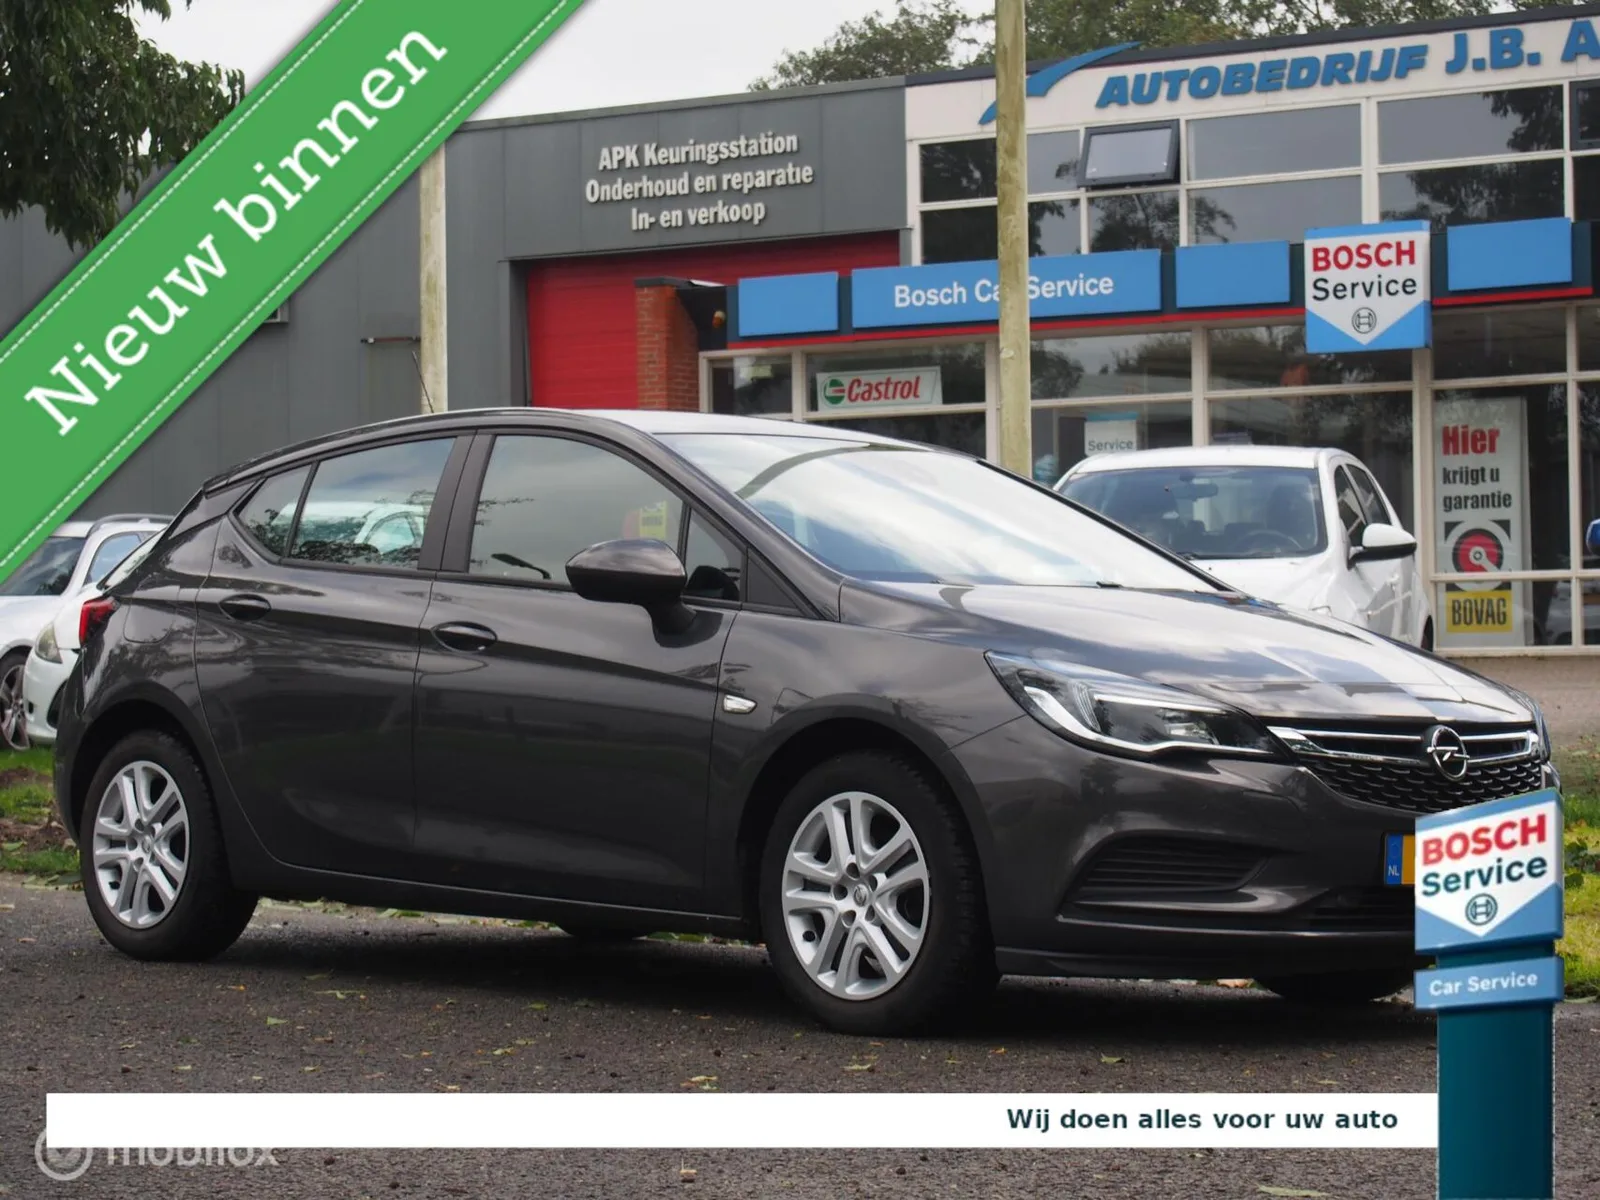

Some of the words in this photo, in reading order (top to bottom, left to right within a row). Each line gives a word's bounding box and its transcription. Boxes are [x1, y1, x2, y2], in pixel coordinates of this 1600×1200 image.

[1096, 44, 1428, 108] AUTOBEDRIJF
[1446, 27, 1541, 75] J.B.
[598, 144, 640, 171] APK
[644, 131, 799, 166] Keuringsstation
[585, 171, 689, 203] Onderhoud
[694, 176, 717, 193] en
[722, 162, 814, 194] reparatie
[631, 207, 656, 230] In-
[660, 210, 683, 228] en
[688, 200, 766, 226] verkoop
[1312, 240, 1416, 272] BOSCH
[894, 281, 967, 308] Bosch
[974, 278, 1000, 303] Ca
[1027, 273, 1114, 299] Service
[1312, 274, 1417, 301] Service
[847, 376, 921, 402] Castrol
[1088, 437, 1134, 452] Service
[1442, 424, 1500, 456] Hier
[1443, 467, 1486, 485] krijgt
[1490, 471, 1500, 483] u
[1443, 491, 1513, 513] garantie
[1451, 597, 1507, 626] BOVAG
[1388, 865, 1399, 877] NL
